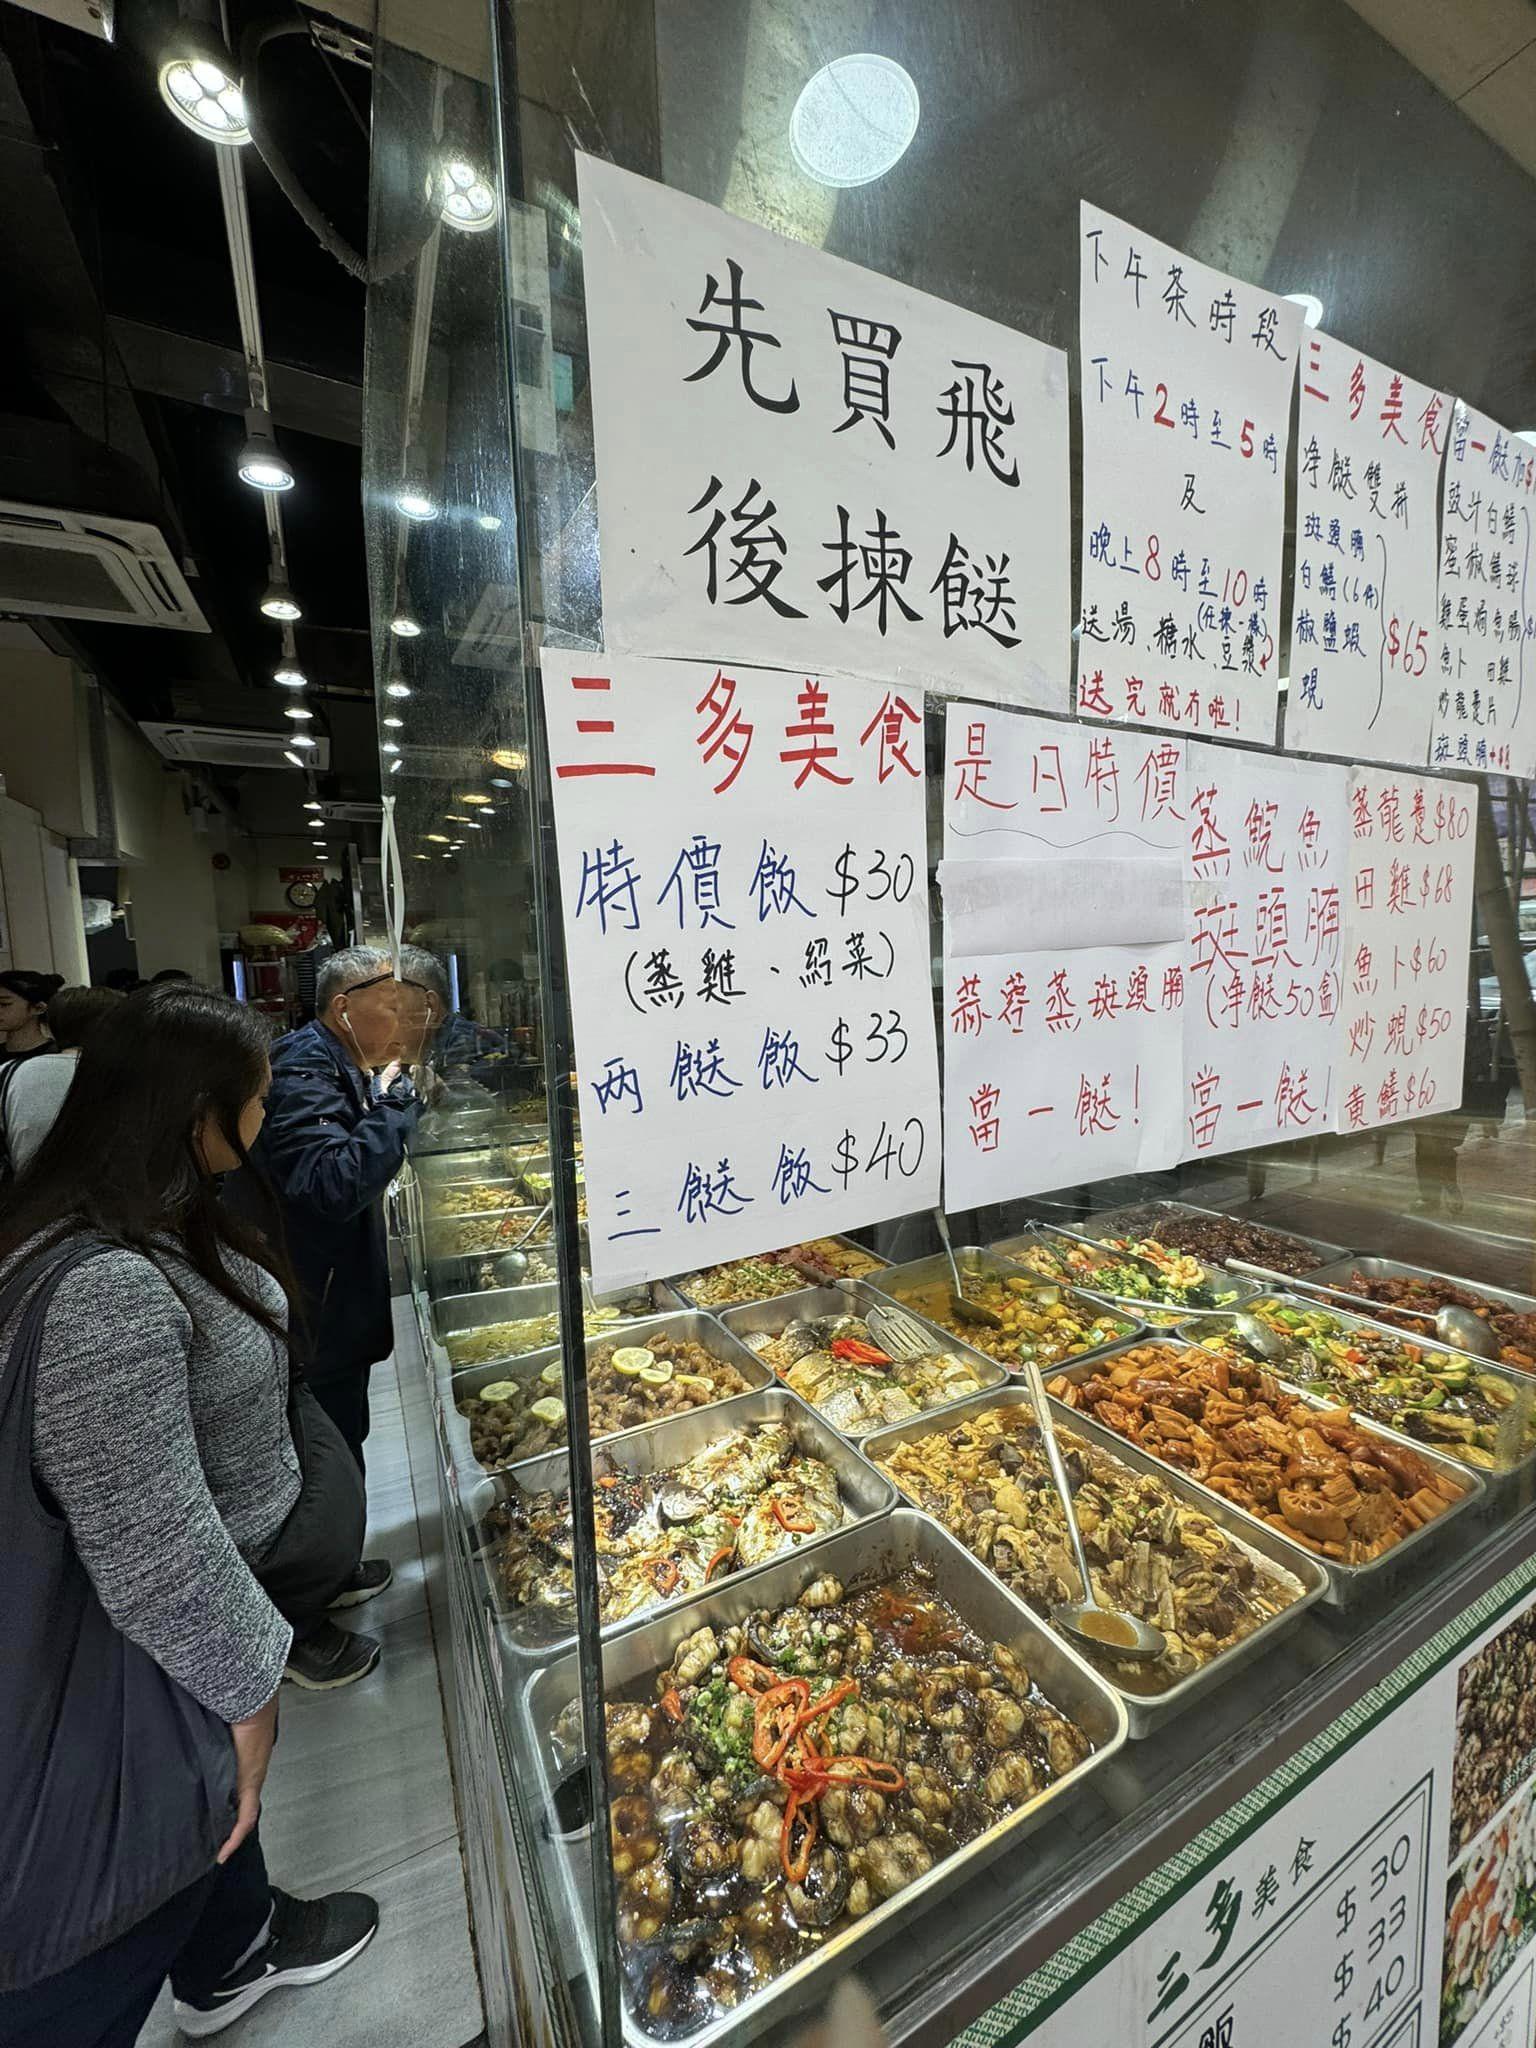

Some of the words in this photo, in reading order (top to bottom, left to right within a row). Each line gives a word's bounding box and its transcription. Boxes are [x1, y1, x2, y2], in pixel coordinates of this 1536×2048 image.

[1086, 230, 1287, 361] 下午茶時段
[683, 257, 1021, 488] 先買飛
[1091, 357, 1277, 474] 下午2時至5時
[1303, 341, 1443, 455] 三多美食
[1180, 474, 1206, 514] 及
[683, 474, 1023, 649] 後揀餸
[1090, 522, 1268, 611] 晚上8時至10時
[1300, 667, 1323, 710] 蜆
[1387, 612, 1429, 677] $65
[556, 669, 922, 794] 三多美食
[953, 723, 1187, 823] 是日特價
[1190, 782, 1329, 880] 蒸鯇魚
[1434, 793, 1470, 841] $80
[575, 835, 818, 935] 特價飯
[826, 843, 914, 917] $30
[1355, 857, 1417, 915] 田雞
[1420, 863, 1454, 909] $68
[1410, 936, 1448, 983] $60
[825, 1010, 908, 1076] $33
[1349, 1004, 1414, 1064] 炒蜆
[1416, 1003, 1452, 1045] $50
[1404, 1066, 1436, 1113] $60
[608, 1143, 832, 1240] 三餸飯
[832, 1117, 925, 1191] $40
